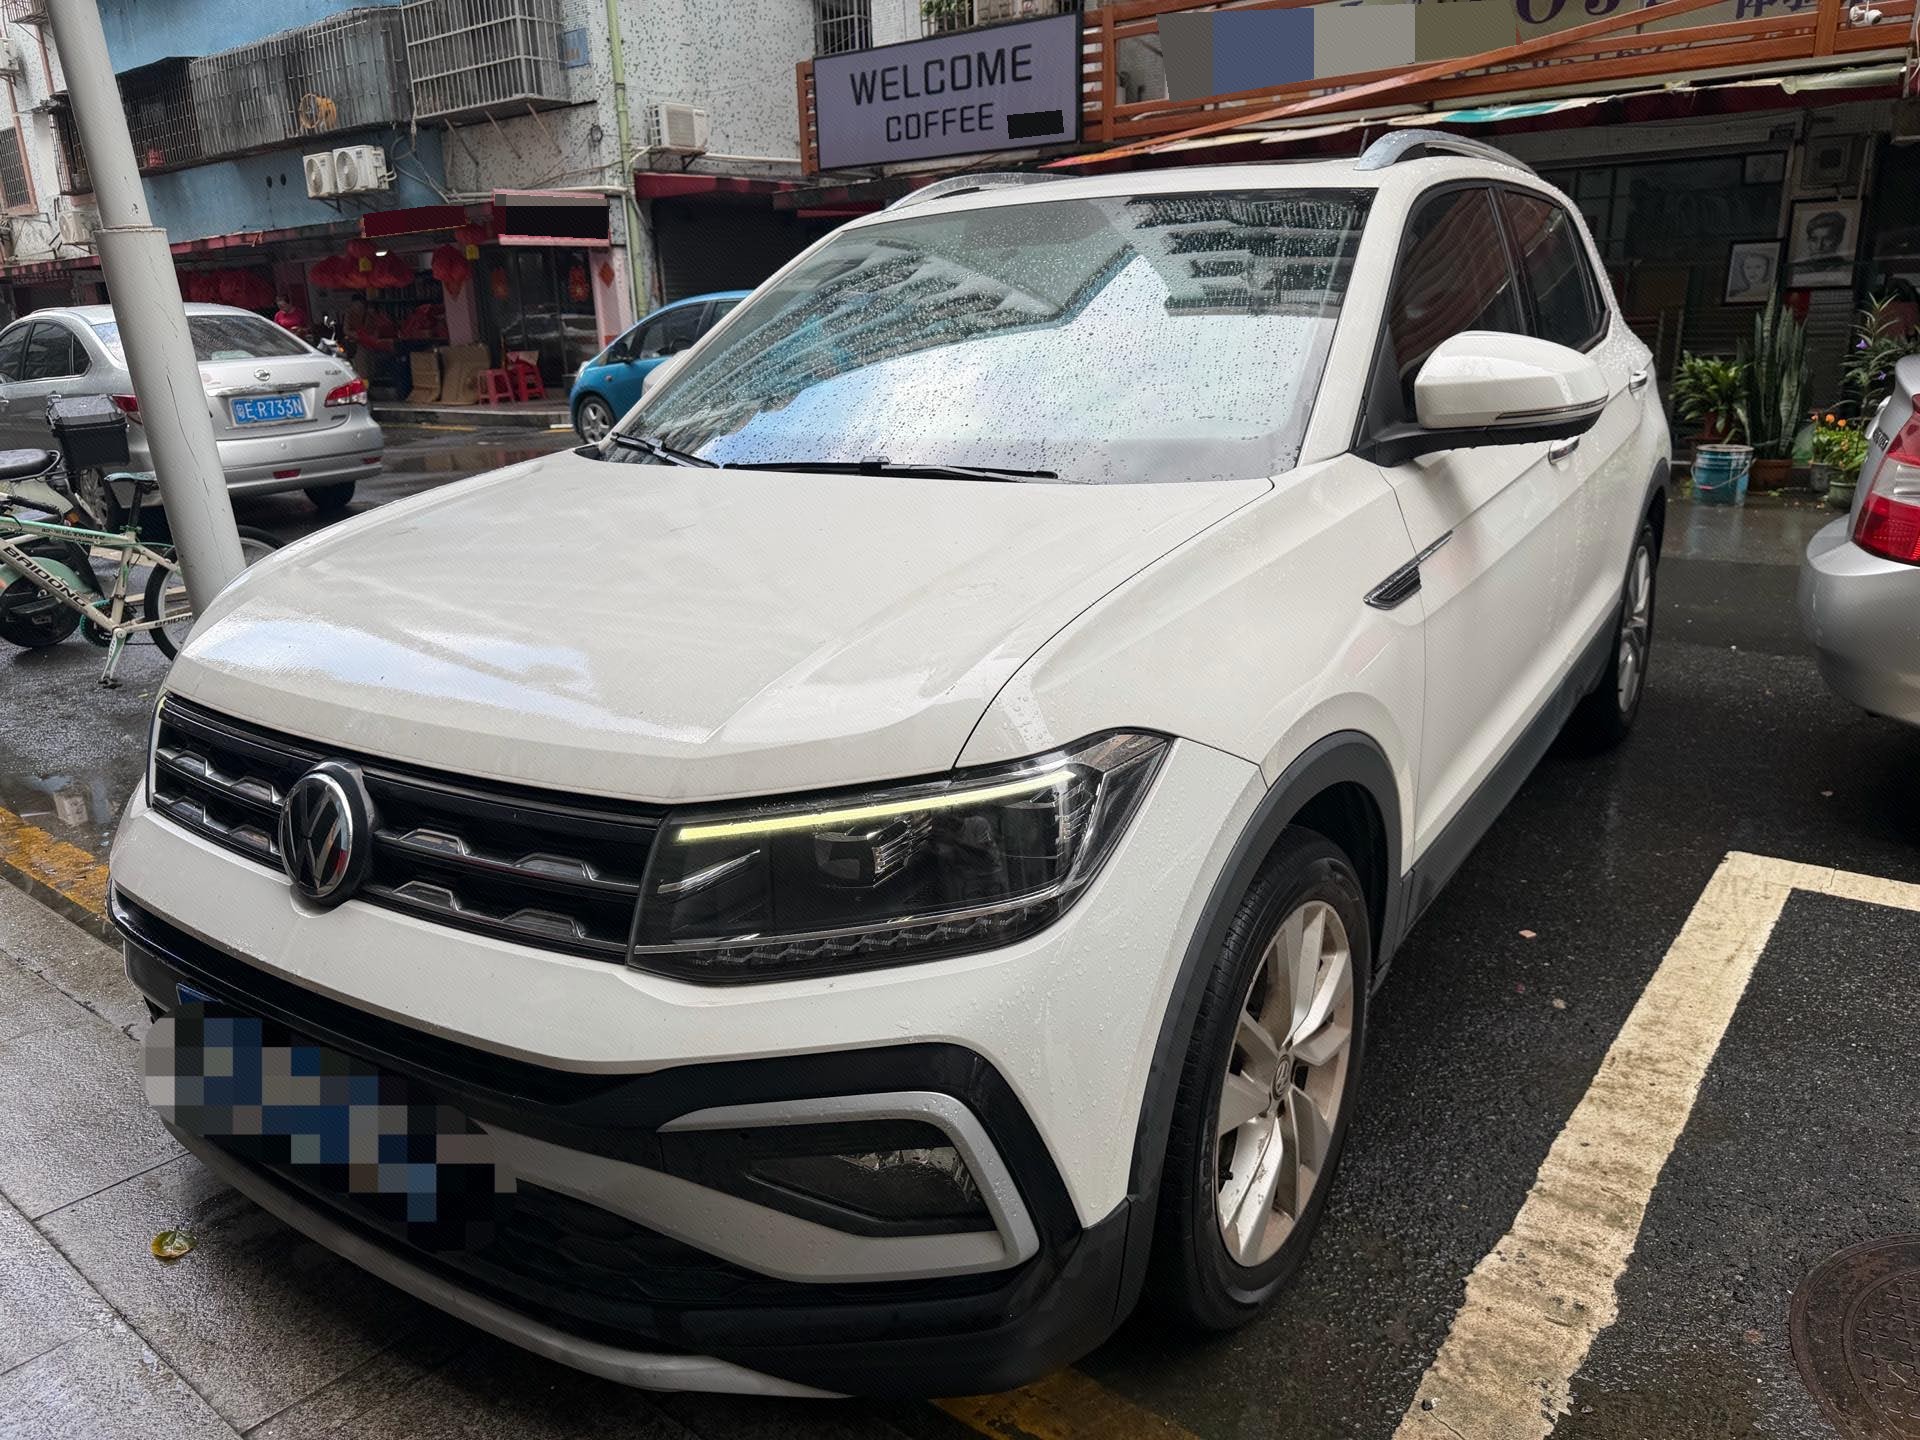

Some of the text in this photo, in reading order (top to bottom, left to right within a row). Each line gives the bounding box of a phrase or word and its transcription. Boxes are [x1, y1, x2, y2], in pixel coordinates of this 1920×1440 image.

[849, 43, 1033, 106] WELCOME
[885, 102, 995, 143] COFFEE
[2, 546, 87, 608] BAIDONG
